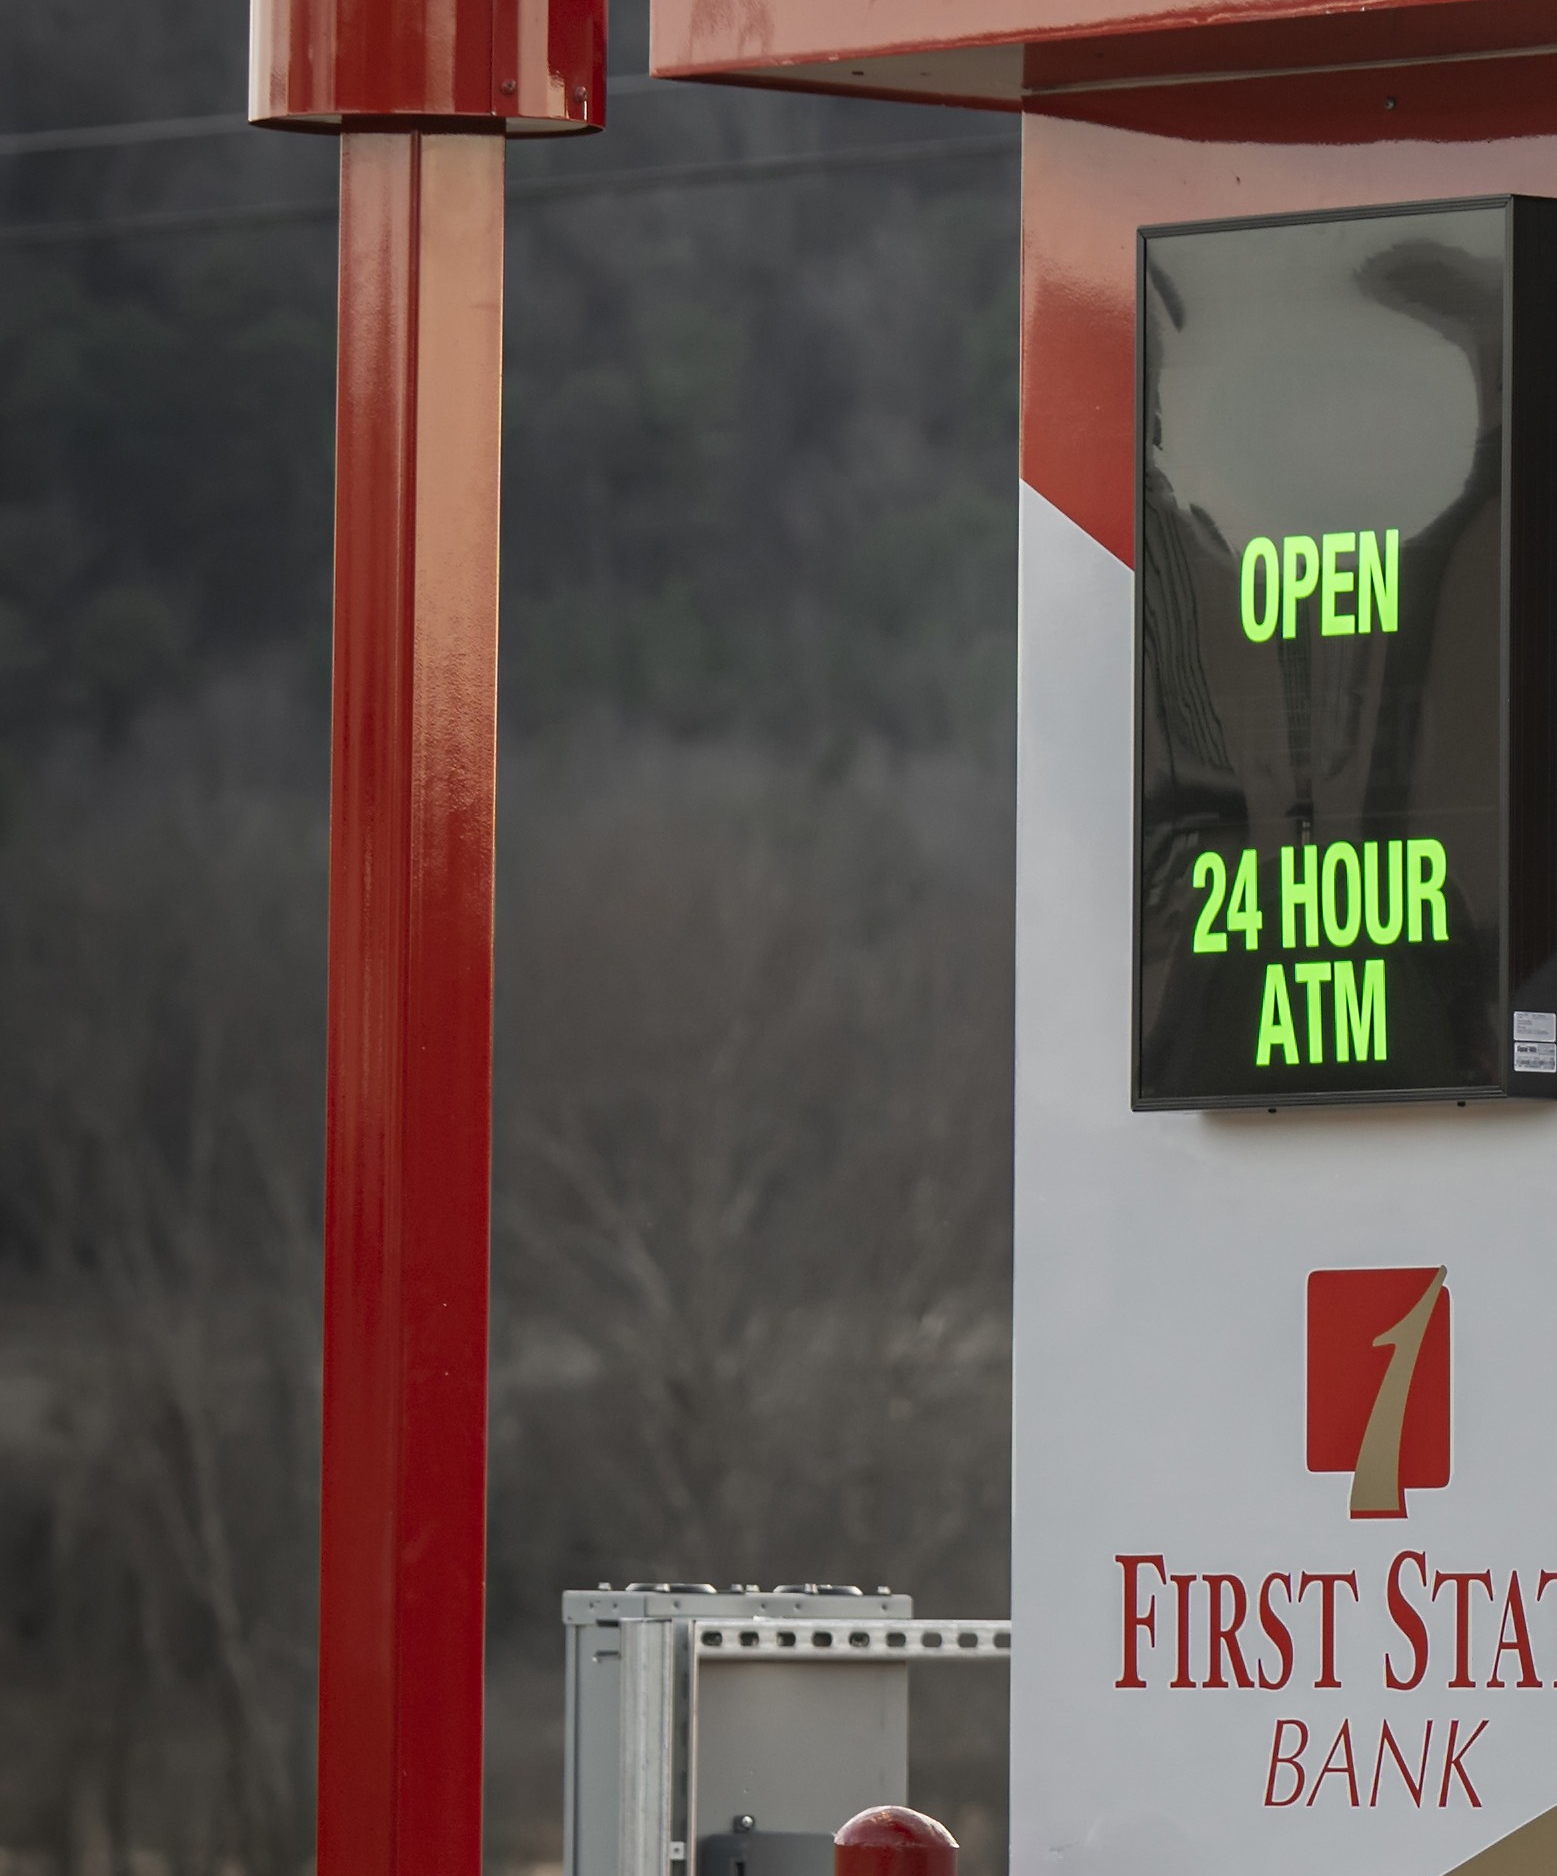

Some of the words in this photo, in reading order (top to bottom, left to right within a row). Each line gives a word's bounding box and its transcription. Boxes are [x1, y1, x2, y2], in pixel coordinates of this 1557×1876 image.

[1240, 529, 1400, 643] OPEN
[1193, 848, 1262, 954] 24
[1282, 839, 1449, 950] HOUR
[1256, 961, 1388, 1067] ATM
[1115, 1554, 1359, 1691] FIRST
[1263, 1719, 1490, 1809] BANK
